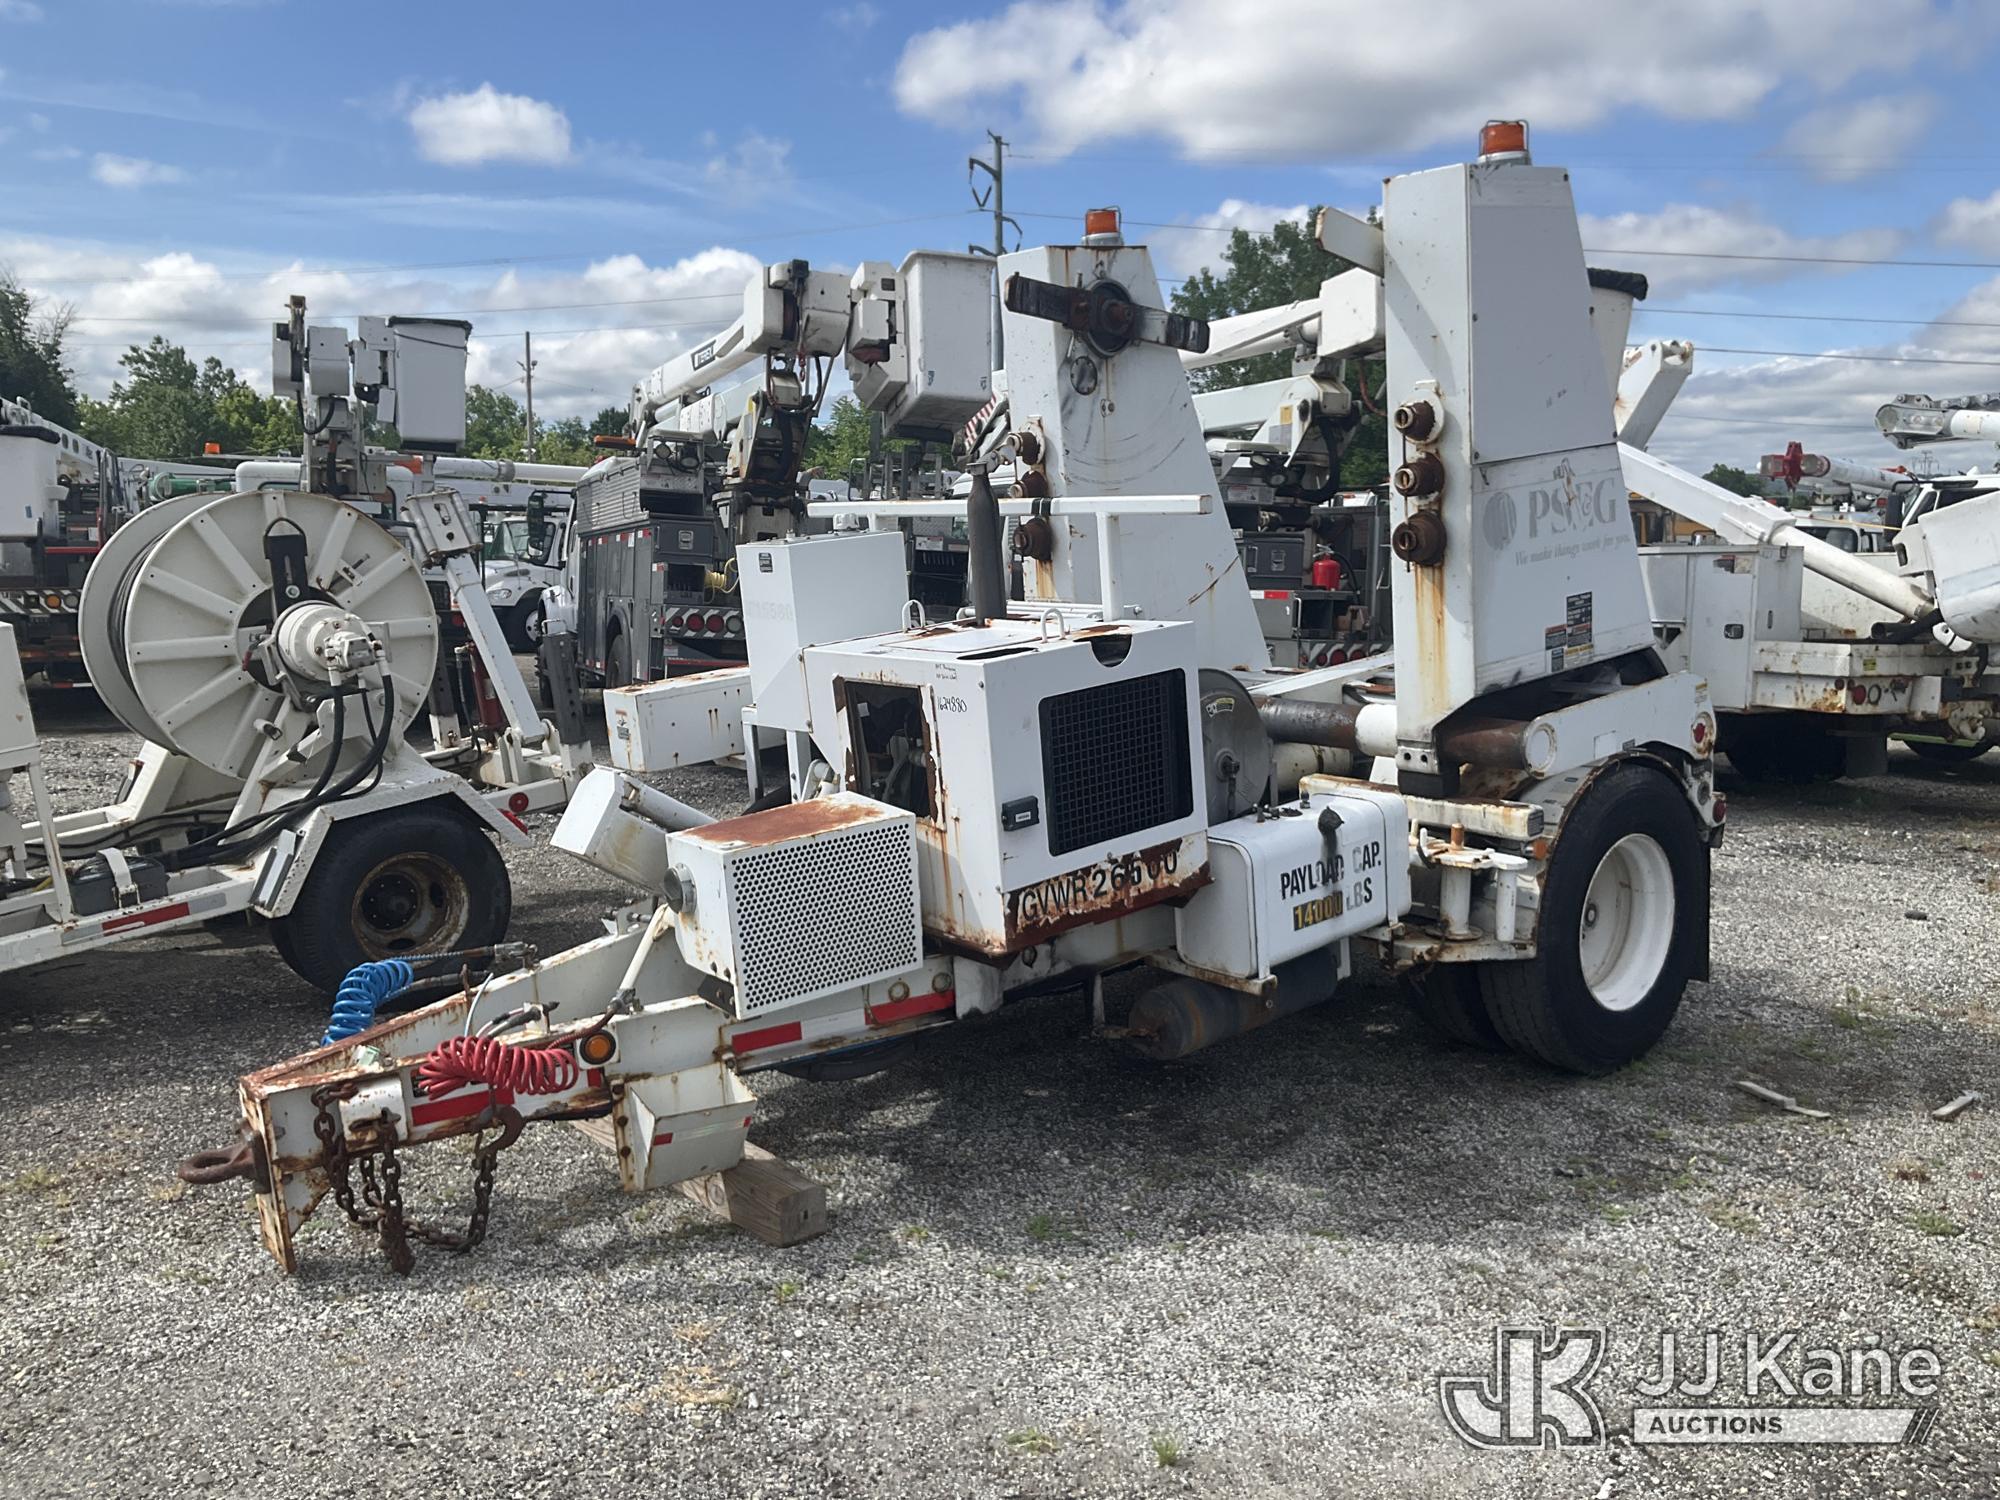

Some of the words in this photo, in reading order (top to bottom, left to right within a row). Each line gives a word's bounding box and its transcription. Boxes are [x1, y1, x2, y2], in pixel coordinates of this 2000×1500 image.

[1280, 854, 1344, 900] PAYLOAD
[1352, 841, 1381, 873] CAP.
[1023, 874, 1088, 921] GVWR
